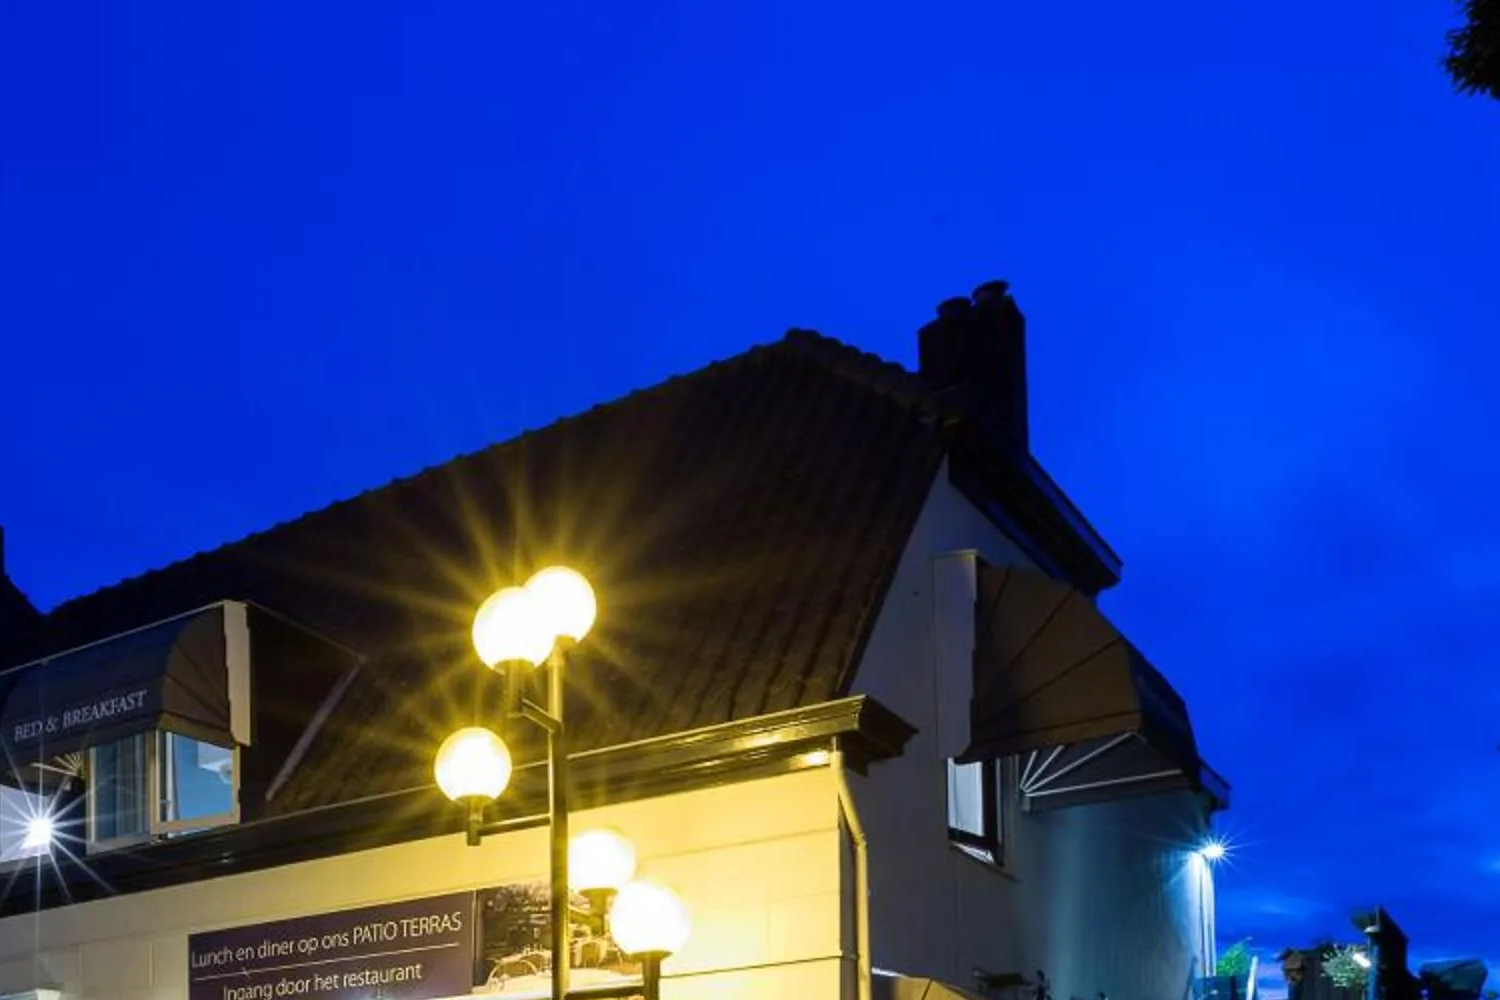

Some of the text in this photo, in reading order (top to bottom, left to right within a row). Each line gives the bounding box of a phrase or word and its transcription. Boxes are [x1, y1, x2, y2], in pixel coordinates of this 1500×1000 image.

[14, 689, 148, 742] BED & BREAKFAST
[191, 911, 463, 968] Lunch en diner op ons PATIO TERRAS
[275, 975, 312, 997] door
[314, 971, 340, 991] het
[342, 962, 423, 987] restaurant
